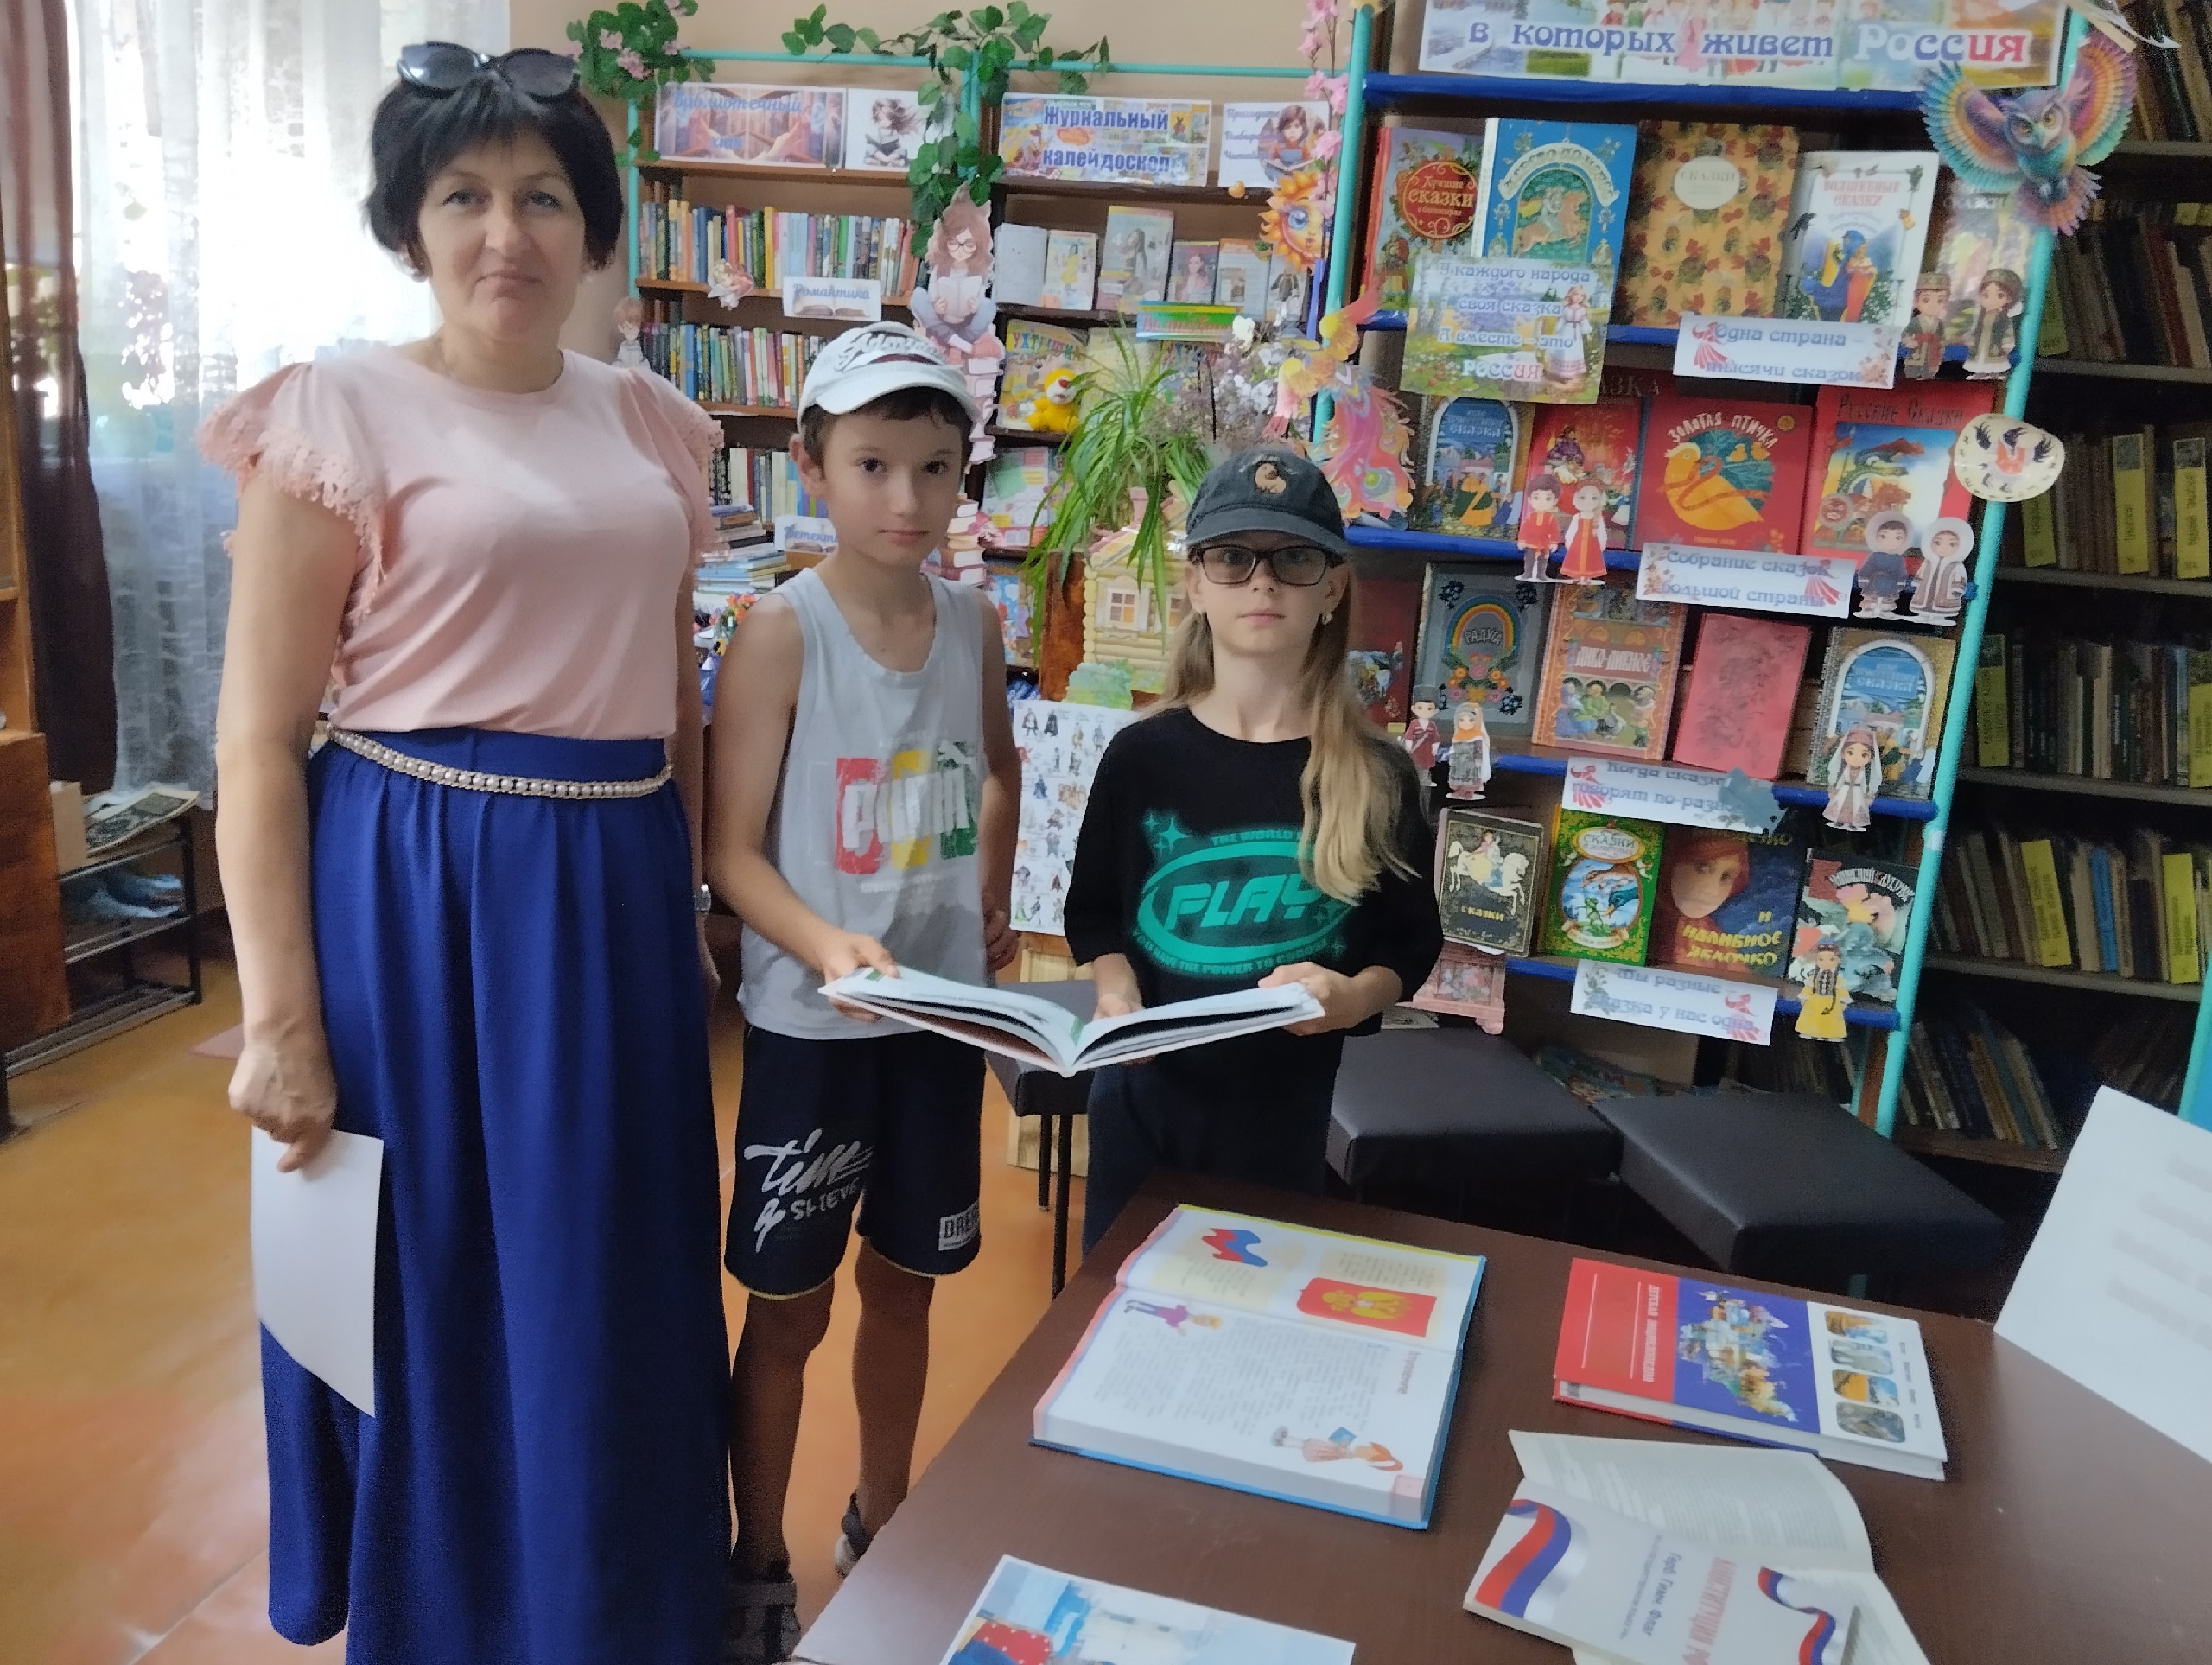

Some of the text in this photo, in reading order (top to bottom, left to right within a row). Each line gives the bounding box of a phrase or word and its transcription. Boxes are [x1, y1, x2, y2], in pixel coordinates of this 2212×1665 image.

[1469, 22, 2026, 62] в которых живет Россия
[1044, 105, 1168, 130] Журнальный
[1043, 148, 1170, 173] калейдоскоп
[1681, 171, 1736, 182] СКАЗКИ
[1824, 179, 1901, 193] ВОЛШЕБНЫЕ
[1455, 266, 1525, 281] каждого
[1531, 270, 1591, 284] народа
[792, 283, 870, 299] Романтика
[1459, 298, 1561, 315] своя сказка
[1439, 327, 1452, 342] А
[1456, 330, 1522, 346] вместе
[1540, 336, 1573, 349] это
[1715, 323, 1763, 342] Одна
[1770, 329, 1847, 346] страна
[1706, 361, 1784, 377] тысячи
[1667, 411, 1778, 448] ЗОЛОТАЯ ПТИЧКА
[1666, 550, 1830, 577] Собрание сказок
[1661, 580, 1827, 607] большой страны
[1606, 761, 1660, 778] Когда
[1571, 781, 1648, 802] говорят
[1211, 829, 1294, 847] THE WORLD
[1583, 832, 1636, 849] СКАЗКИ
[1654, 975, 1722, 995] разные
[1659, 1005, 1670, 1020] у
[1675, 1007, 1707, 1024] нас
[1712, 1015, 1755, 1032] одна
